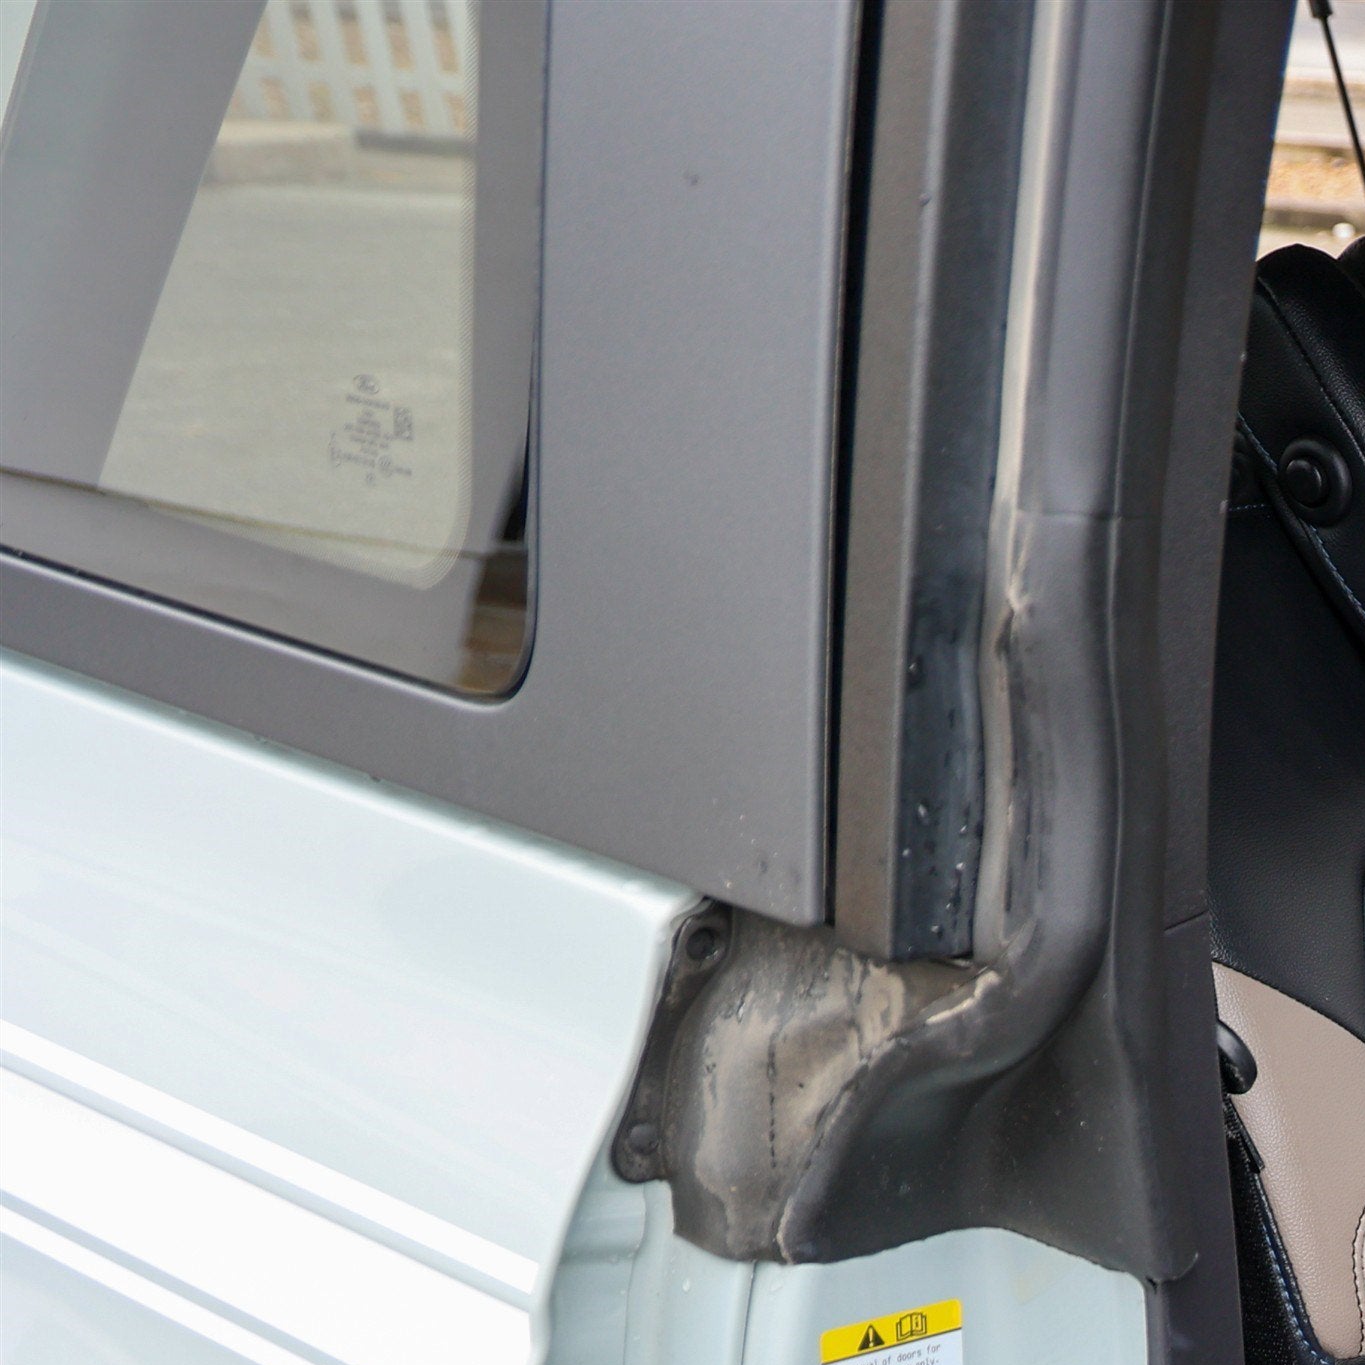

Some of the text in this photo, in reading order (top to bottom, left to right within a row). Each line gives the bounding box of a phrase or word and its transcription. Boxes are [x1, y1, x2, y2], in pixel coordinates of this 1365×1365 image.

[882, 1355, 891, 1365] of
[897, 1349, 922, 1362] doors
[927, 1343, 940, 1354] for
